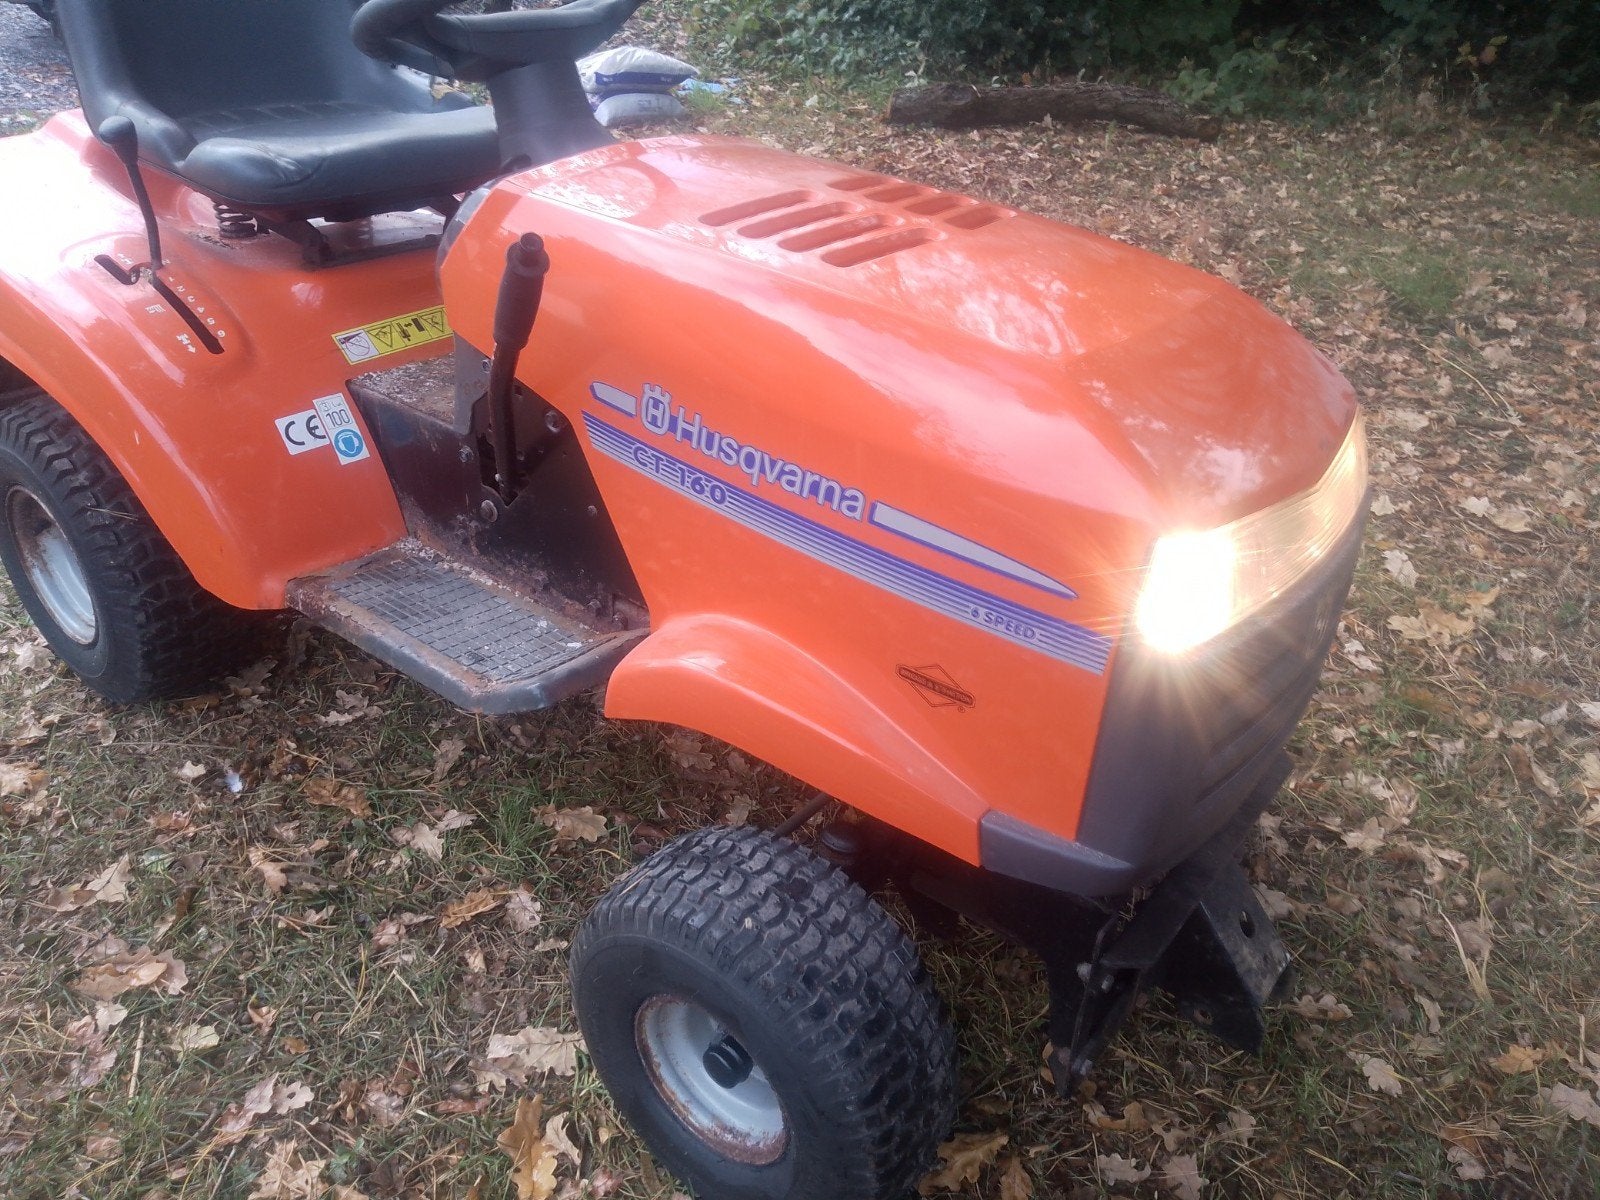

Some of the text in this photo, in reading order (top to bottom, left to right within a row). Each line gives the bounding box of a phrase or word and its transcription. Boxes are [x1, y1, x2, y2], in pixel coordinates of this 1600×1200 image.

[325, 408, 351, 428] 100
[675, 405, 866, 521] Husqvarna
[676, 465, 728, 506] 160
[982, 610, 1037, 641] SPEED
